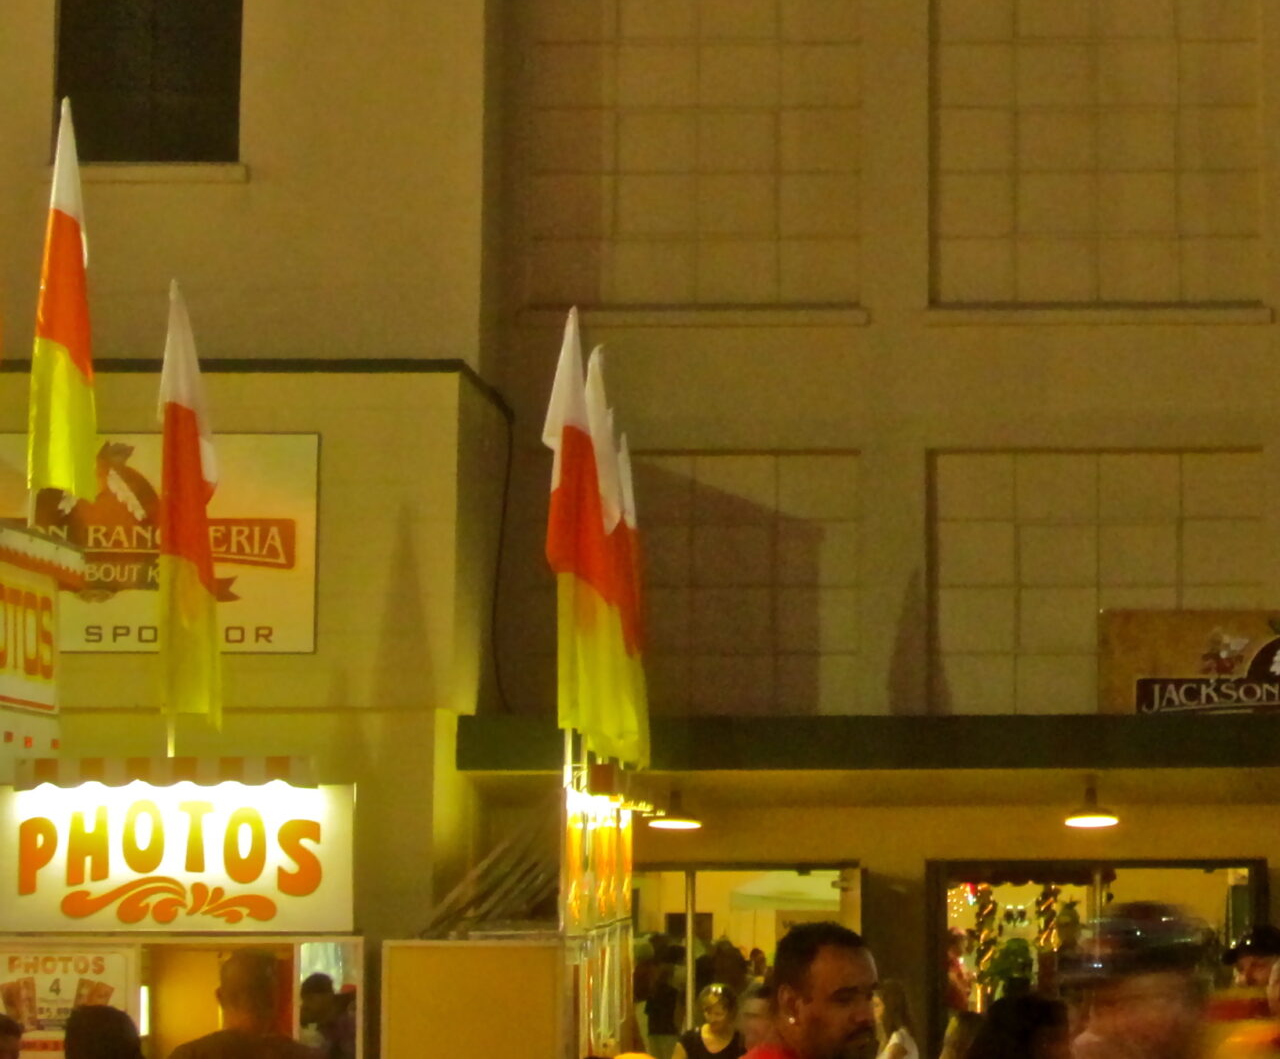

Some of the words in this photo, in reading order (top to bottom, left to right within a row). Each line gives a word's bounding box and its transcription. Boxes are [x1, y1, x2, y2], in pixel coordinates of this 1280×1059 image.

[86, 525, 287, 564] RANERIA
[84, 625, 273, 644] SPOOR
[1142, 679, 1280, 714] JACKSON
[18, 799, 323, 897] PHOTOS
[8, 956, 104, 974] PHOTOS
[49, 978, 61, 996] 4
